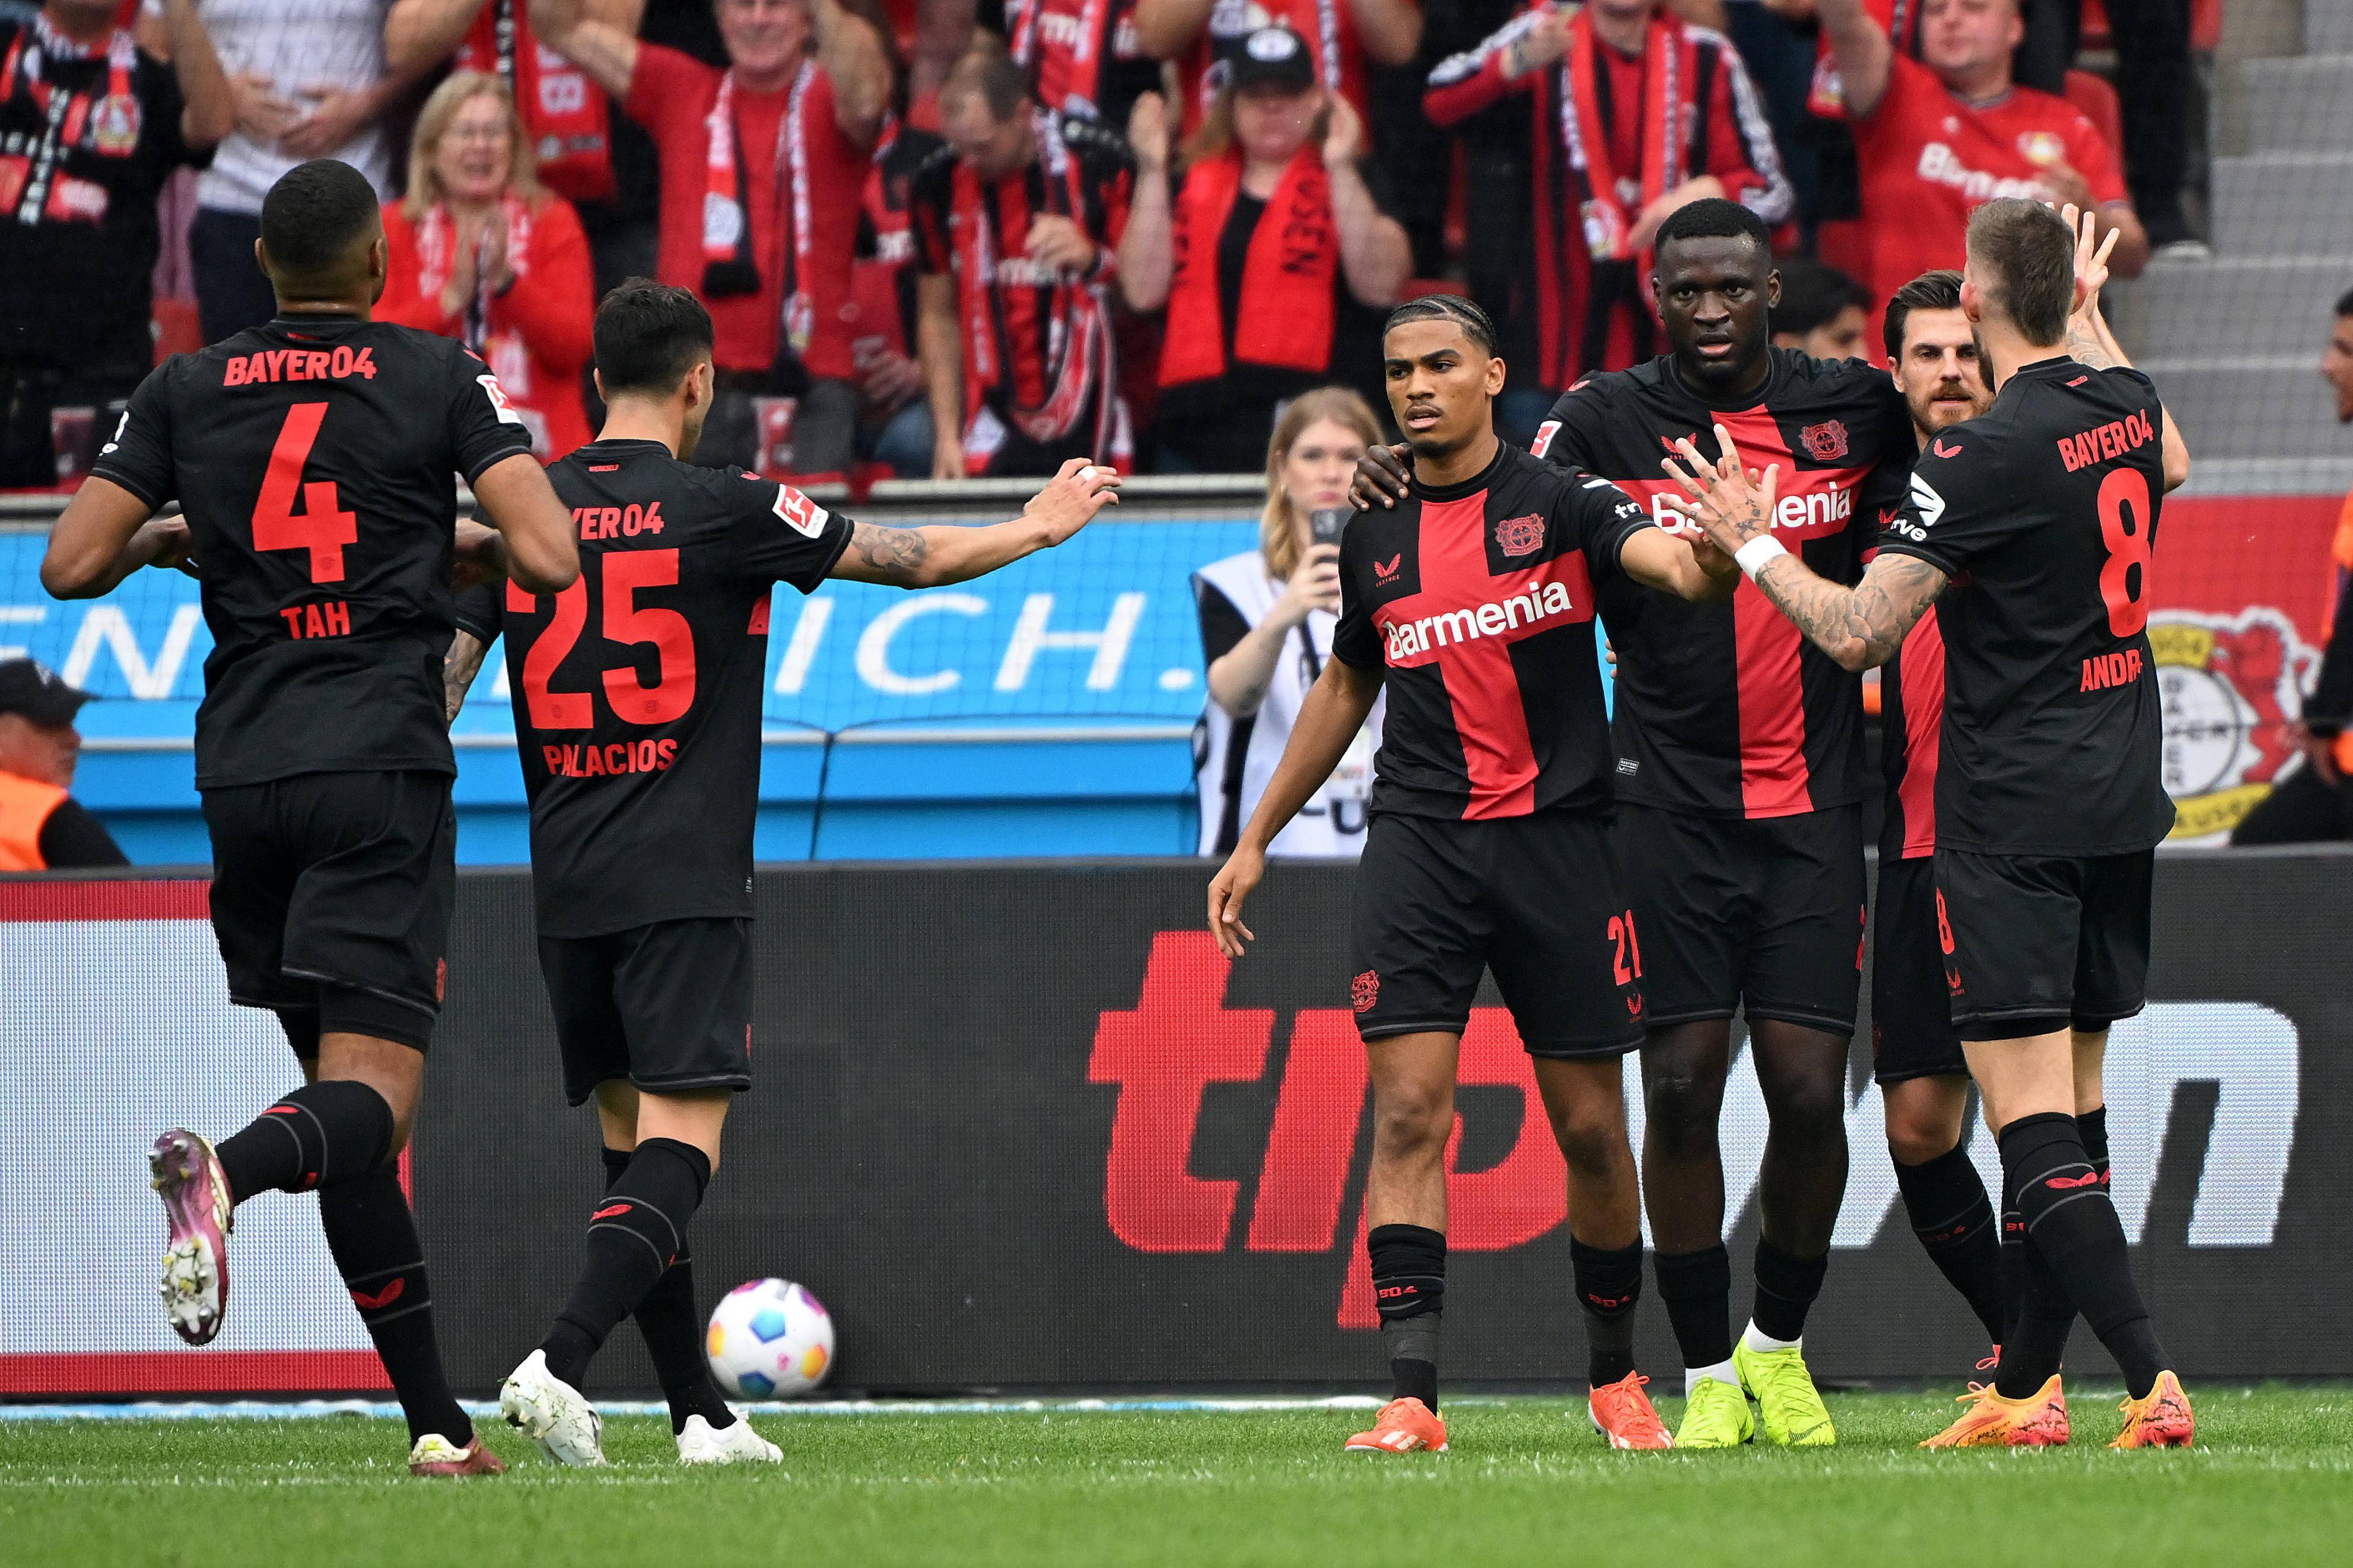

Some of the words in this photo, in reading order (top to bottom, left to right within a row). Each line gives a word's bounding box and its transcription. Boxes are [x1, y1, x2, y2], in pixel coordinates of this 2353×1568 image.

[252, 402, 357, 584] 4
[1651, 481, 1850, 535] Benia
[2097, 467, 2151, 638] 8
[281, 602, 351, 640] TAH
[505, 548, 697, 730] 25
[1381, 581, 1573, 660] Barmenia
[2079, 646, 2143, 693] ANDR
[542, 738, 678, 778] PALACIOS
[1607, 909, 1643, 986] 21
